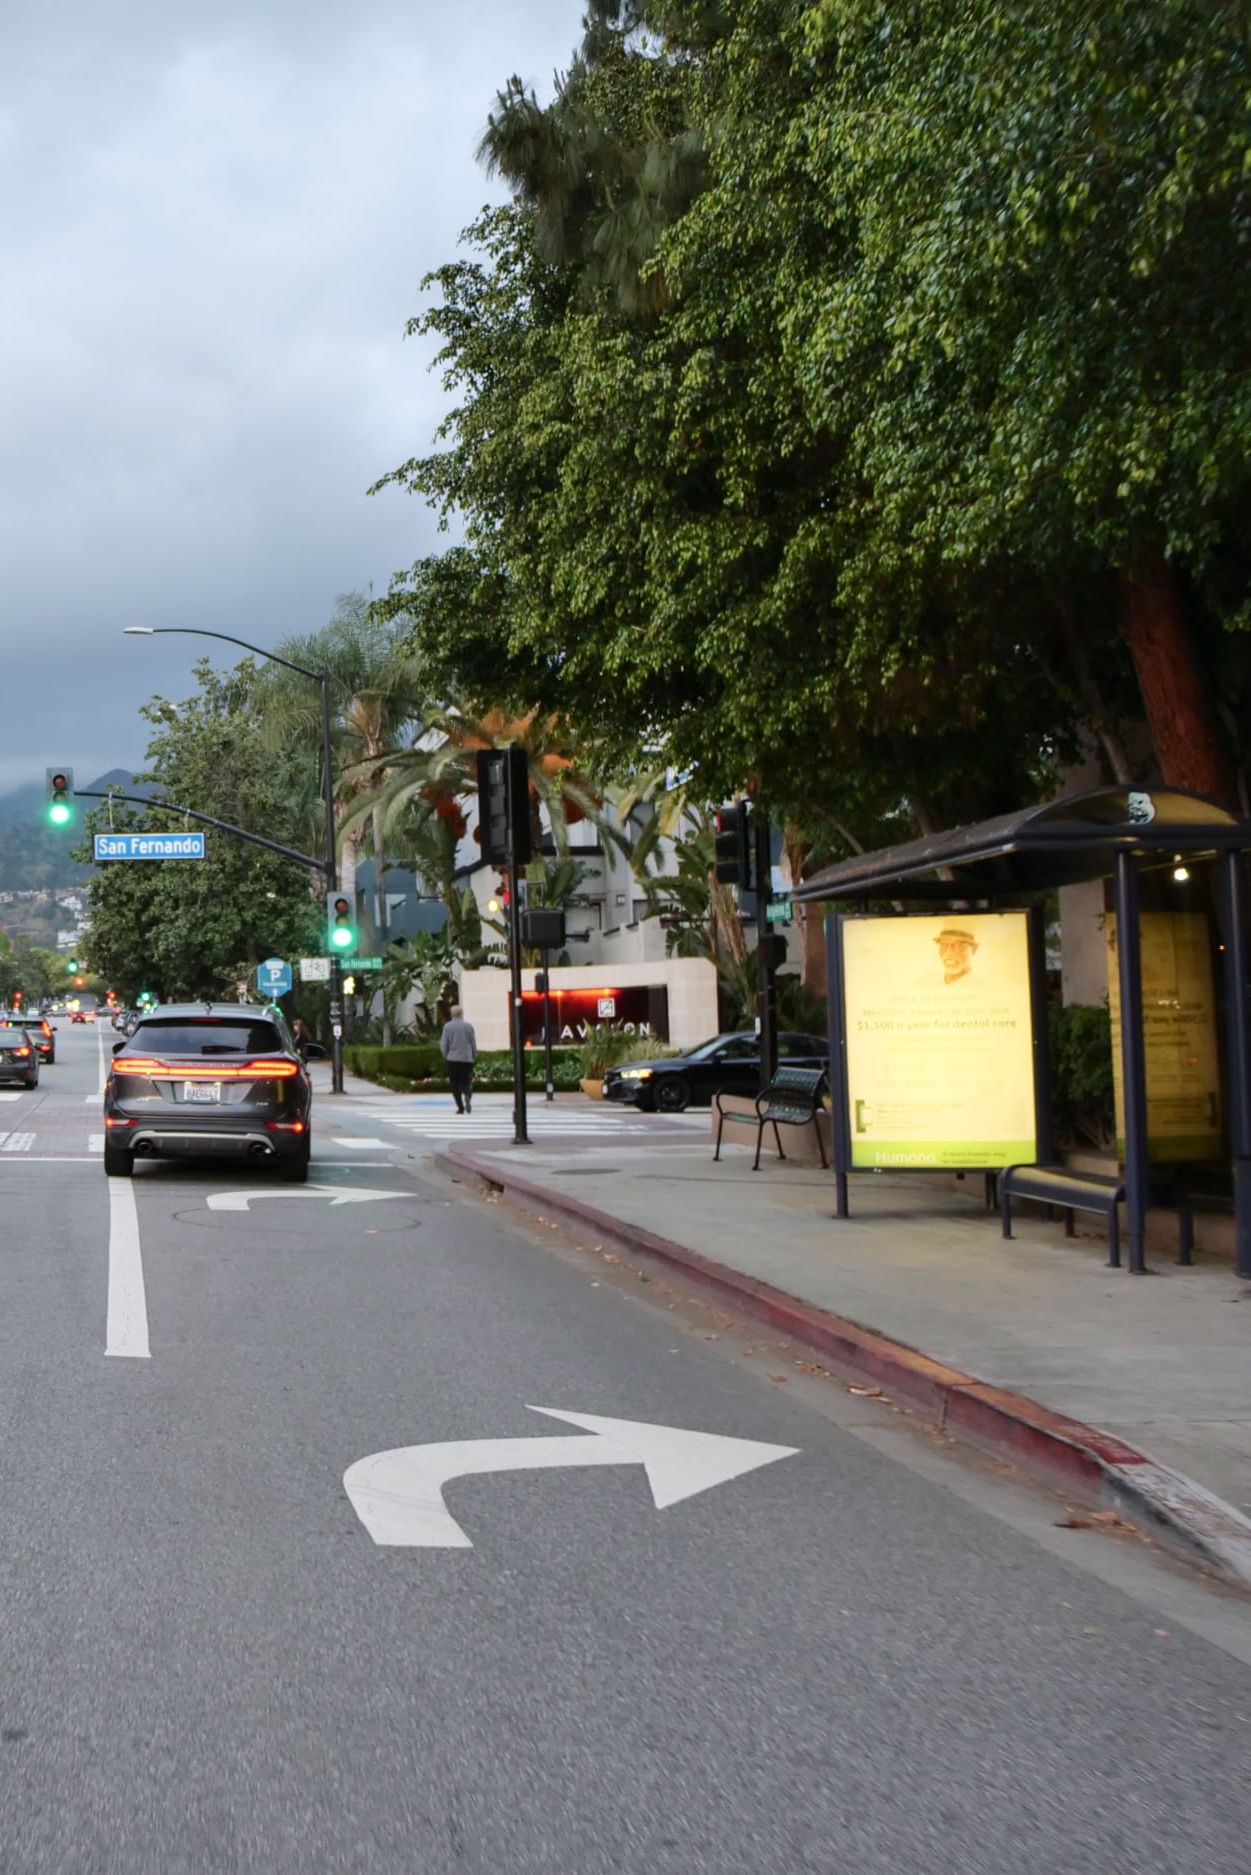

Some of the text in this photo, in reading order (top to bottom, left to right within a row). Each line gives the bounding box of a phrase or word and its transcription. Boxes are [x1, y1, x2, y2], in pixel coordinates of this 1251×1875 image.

[98, 837, 201, 854] San Fernando
[270, 969, 282, 982] P
[908, 1021, 930, 1031] year
[934, 1019, 949, 1029] for
[953, 1018, 989, 1029] dental
[992, 1019, 1017, 1028] care
[875, 1151, 935, 1165] Humana
